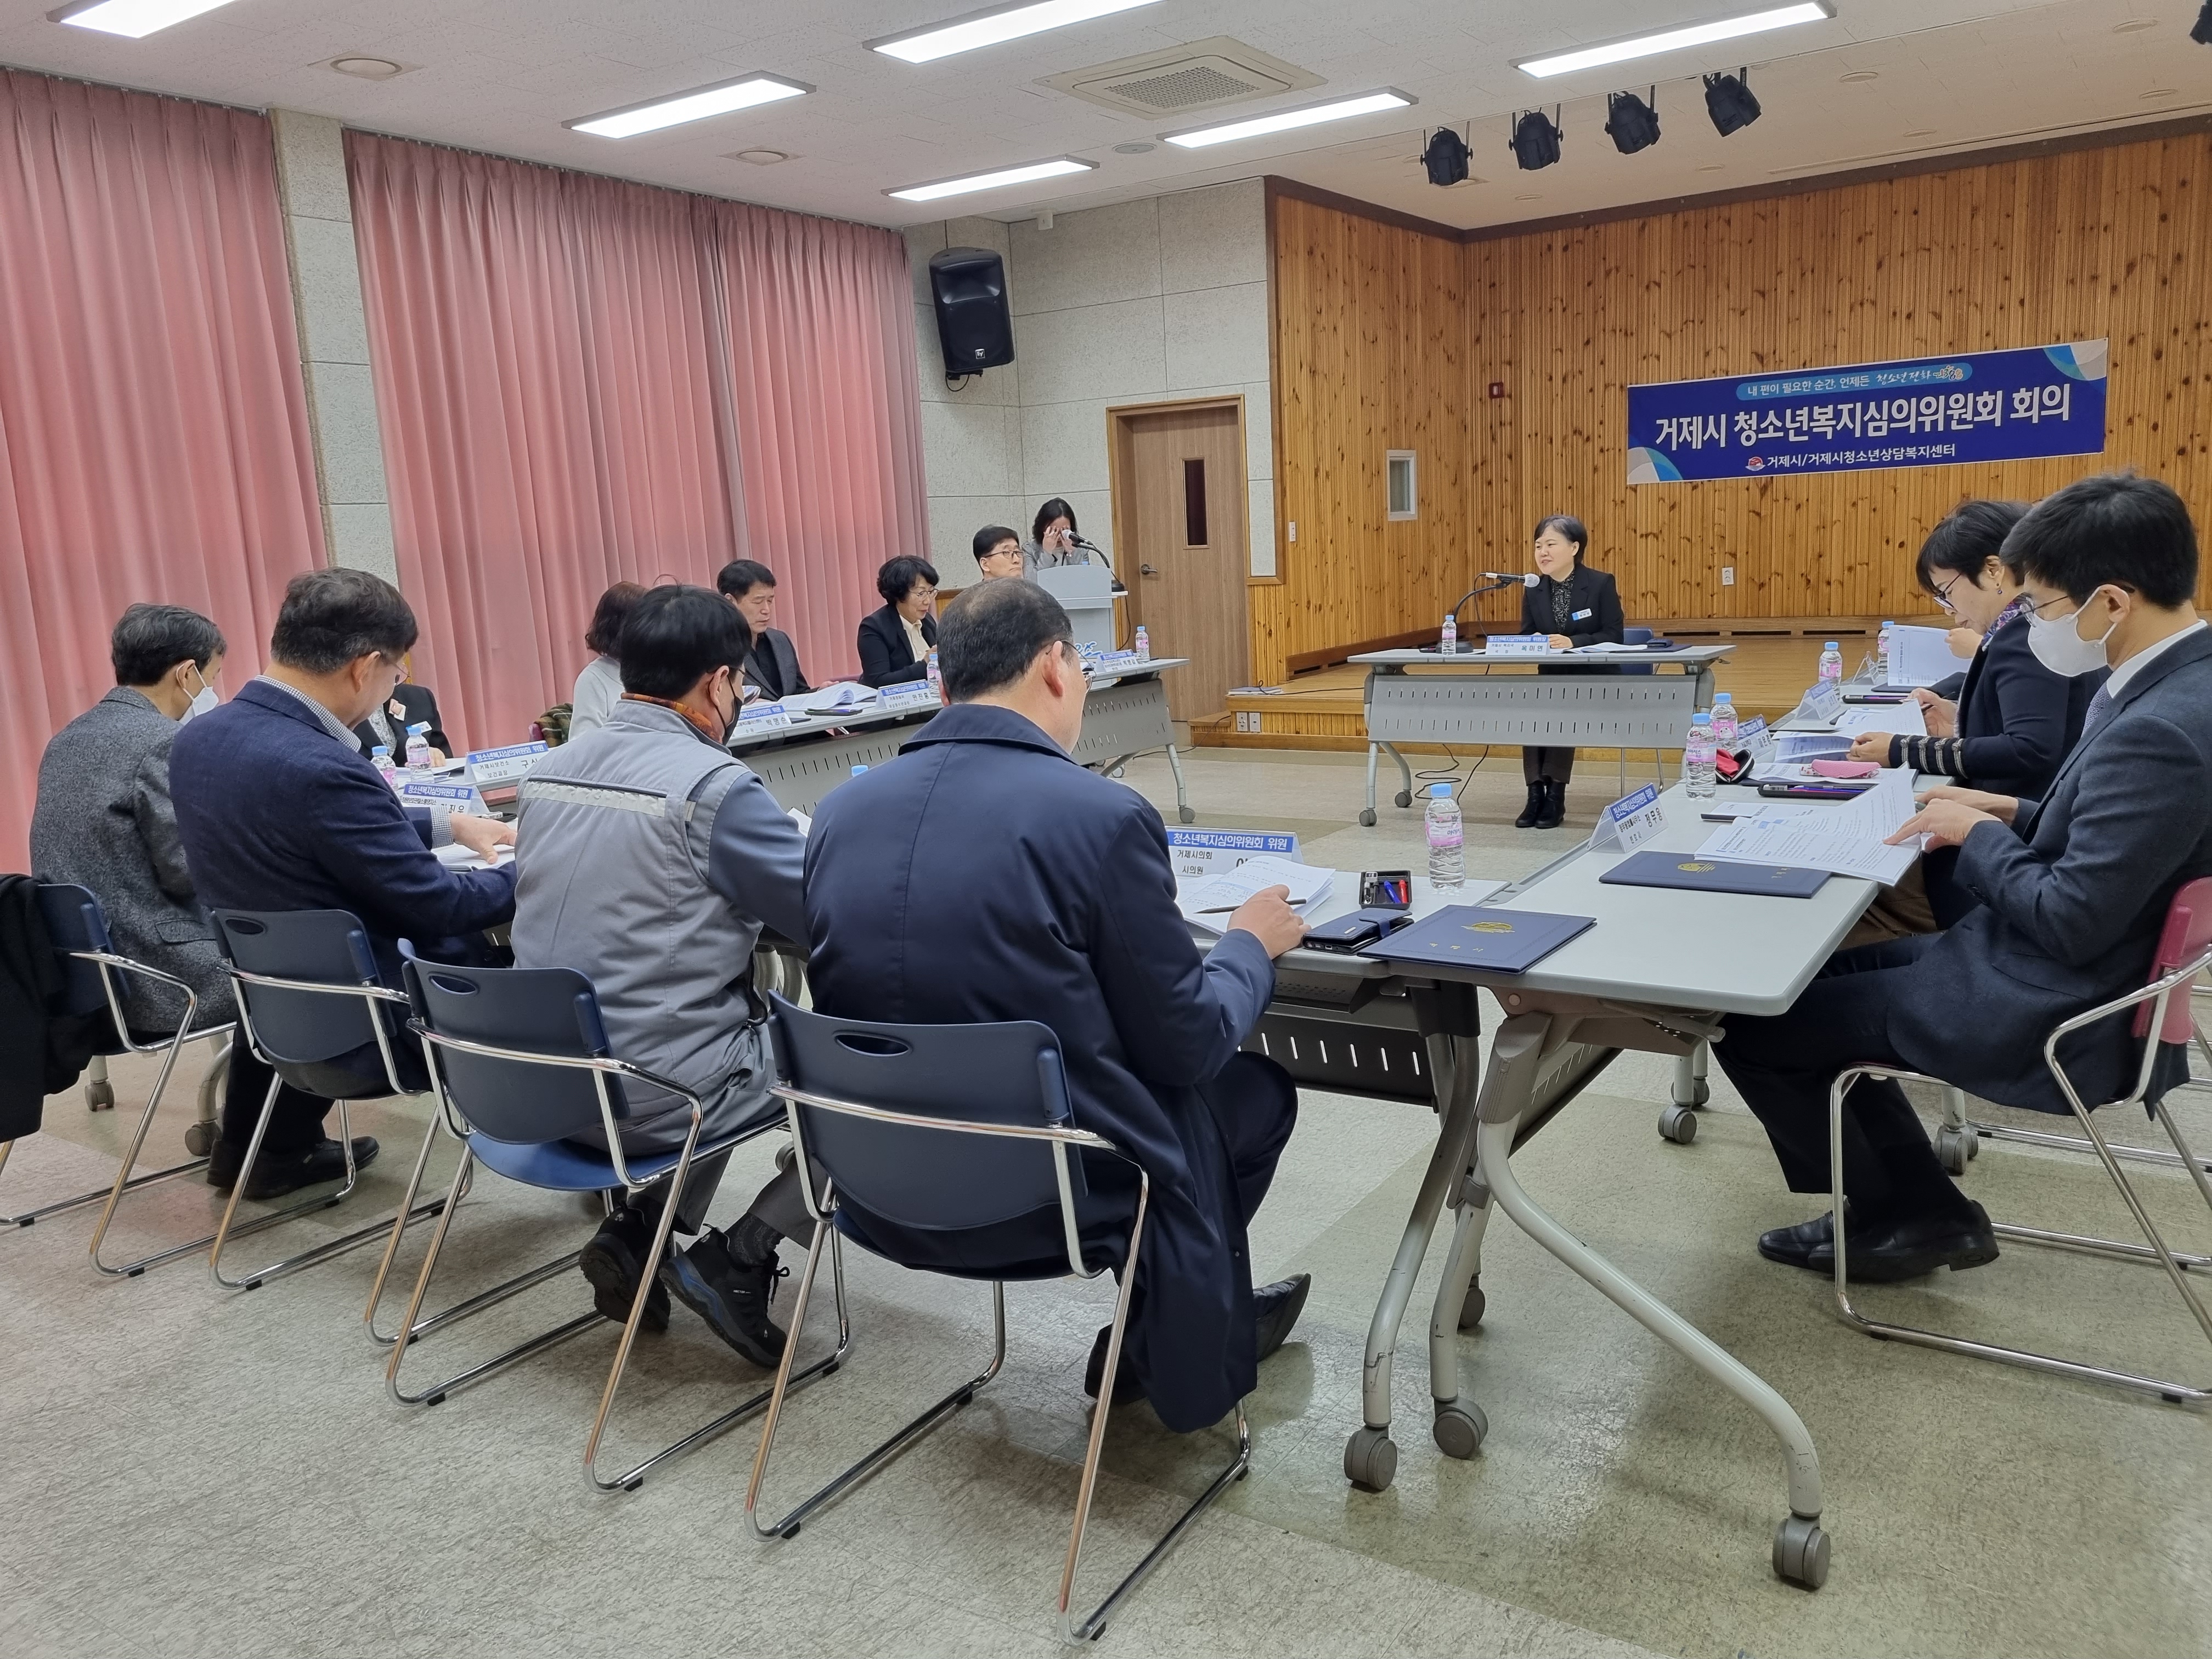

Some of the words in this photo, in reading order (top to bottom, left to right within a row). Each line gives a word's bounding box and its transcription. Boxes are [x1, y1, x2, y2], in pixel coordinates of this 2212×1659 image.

[1748, 386, 1757, 396] 내
[1760, 385, 1779, 395] 편이
[1782, 382, 1811, 393] 필요한
[1840, 375, 1870, 388] 언제든
[1656, 414, 1726, 451] 거제시
[1734, 390, 2003, 447] 청소년복지심의위원회
[2010, 383, 2070, 424] 회의
[1767, 443, 1956, 469] 거제시/거제시청소년상담복지센터
[475, 747, 532, 762] 청소년복지심의위원회
[532, 744, 545, 752] 위원
[479, 760, 510, 770] 거제시보건소
[408, 785, 456, 797] 청소년복지심의위원회
[458, 789, 469, 798] 위원
[1173, 833, 1263, 849] 청소년복지심의위원회
[1267, 838, 1287, 850] 위원
[1177, 849, 1212, 860] 거제시의회
[1182, 865, 1203, 874] 시의원
